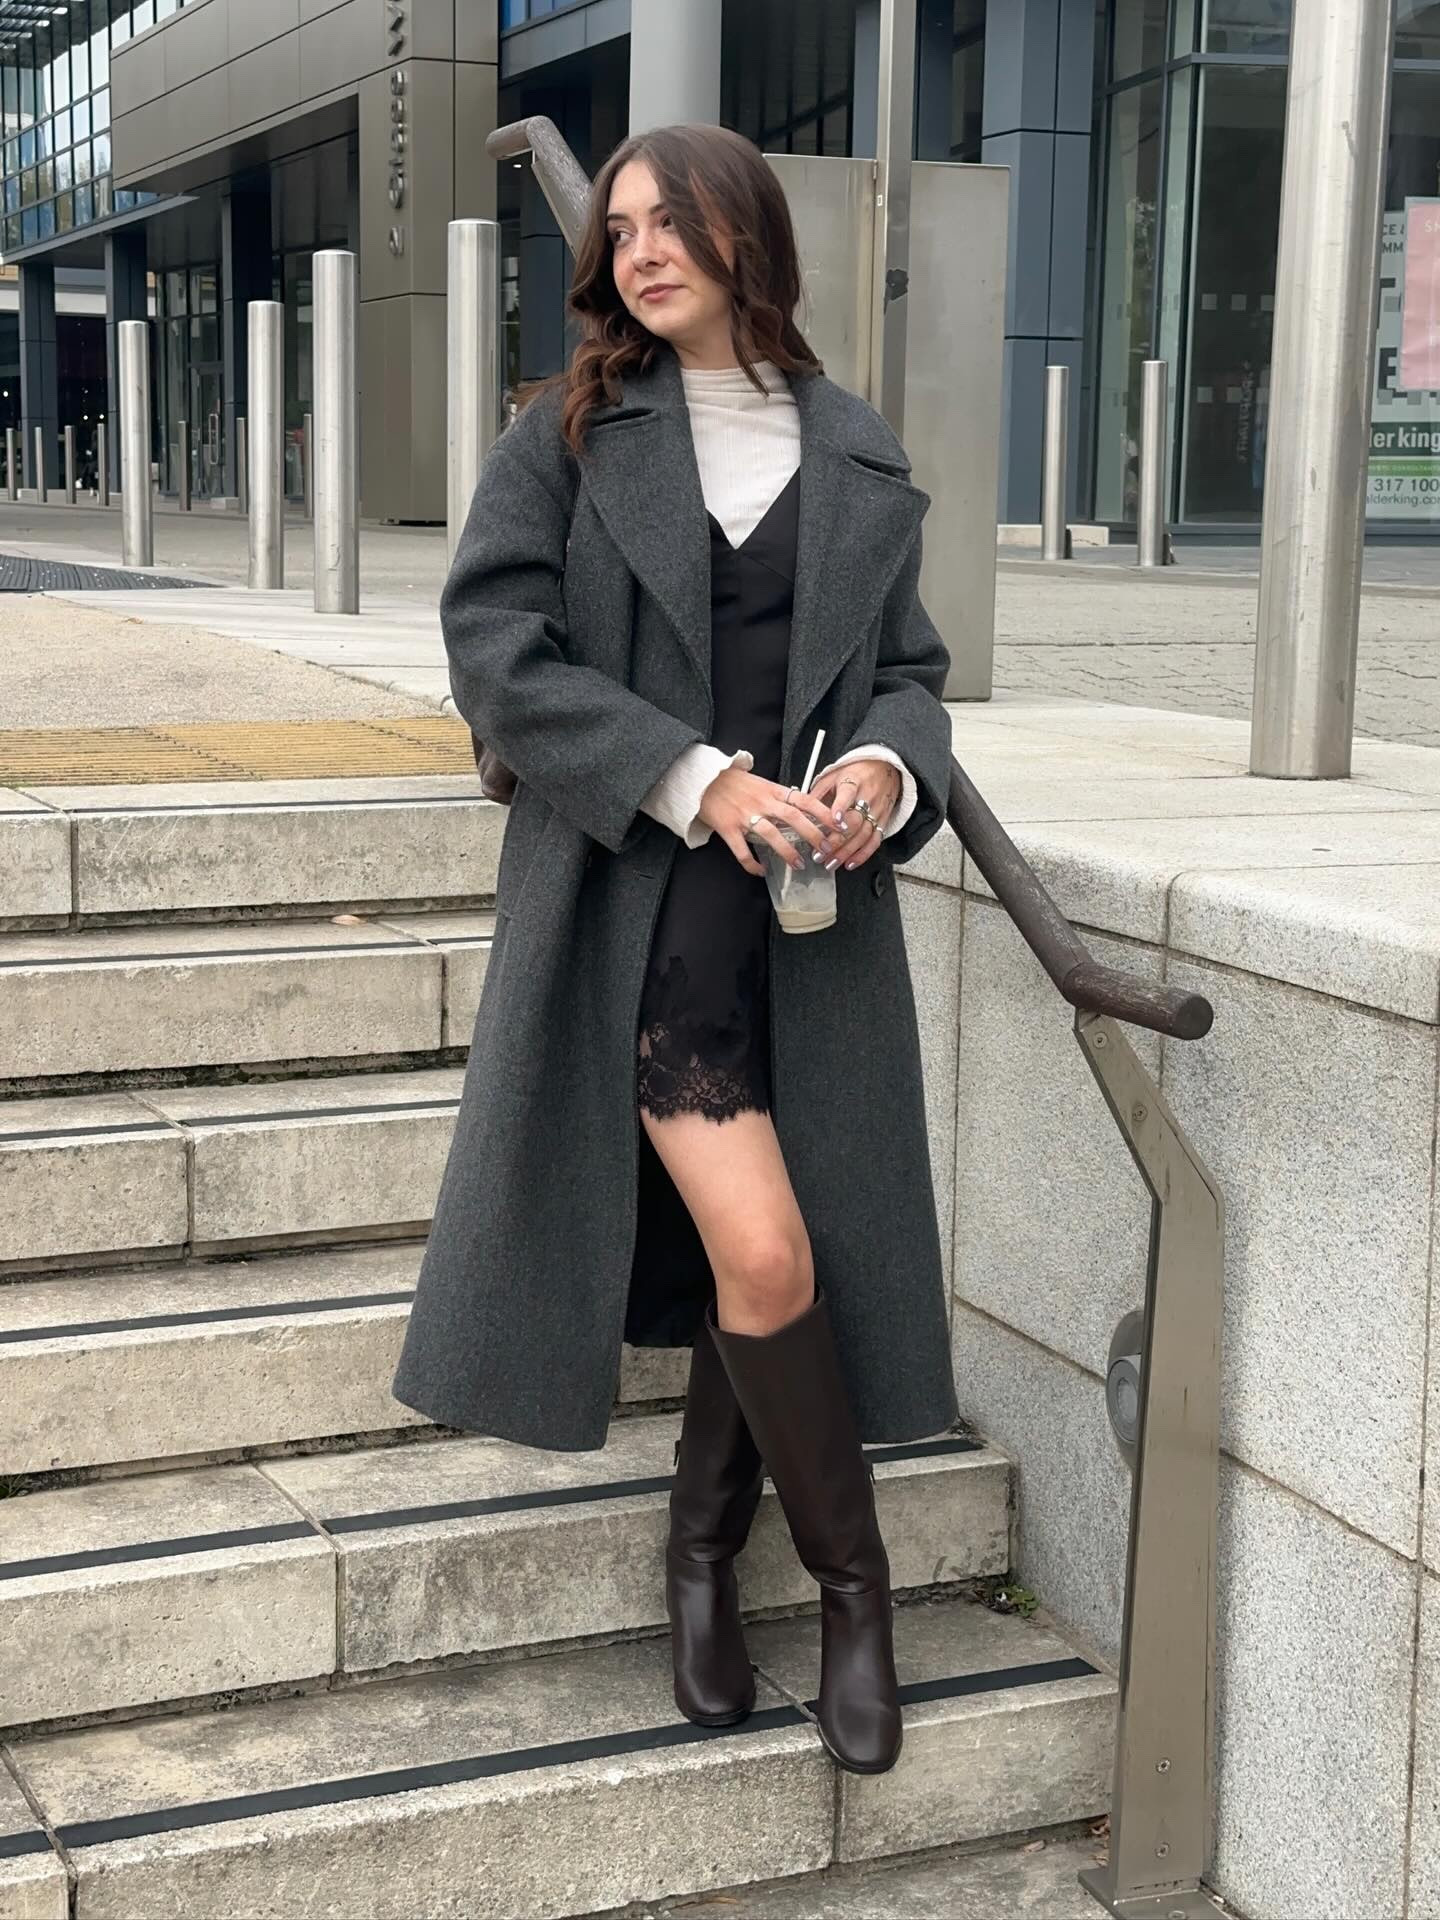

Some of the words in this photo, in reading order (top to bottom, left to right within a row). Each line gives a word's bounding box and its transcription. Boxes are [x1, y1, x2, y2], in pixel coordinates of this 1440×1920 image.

[387, 0, 405, 57] W
[1397, 427, 1440, 453] king
[1373, 478, 1404, 492] 317
[1410, 478, 1440, 492] 100
